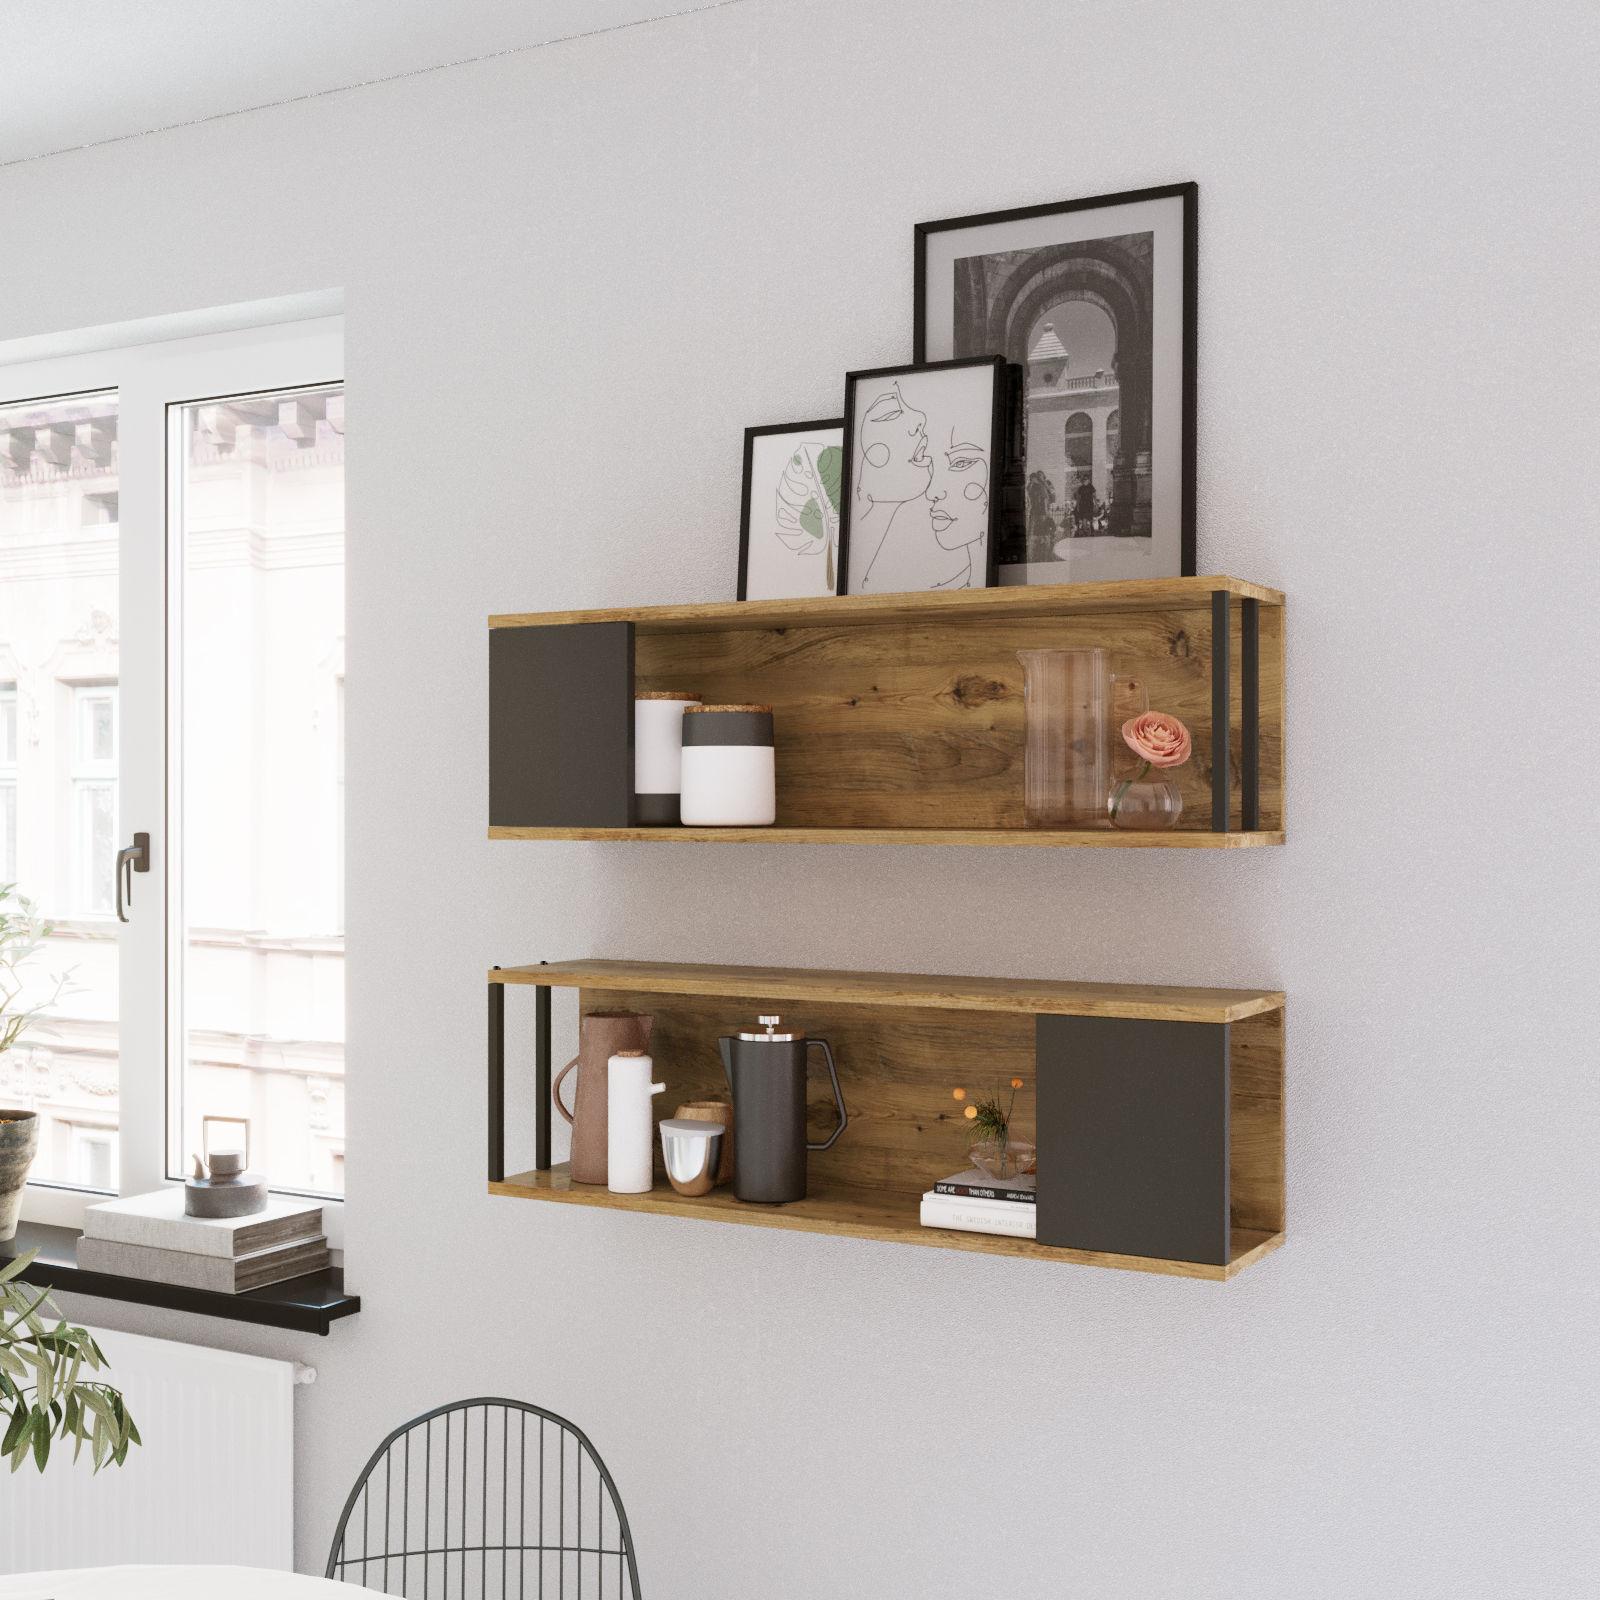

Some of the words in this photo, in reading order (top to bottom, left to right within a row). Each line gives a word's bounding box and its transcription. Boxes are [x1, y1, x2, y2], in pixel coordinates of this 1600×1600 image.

[936, 1185, 948, 1194] SOME
[948, 1185, 956, 1194] ARE
[969, 1188, 980, 1197] THAN
